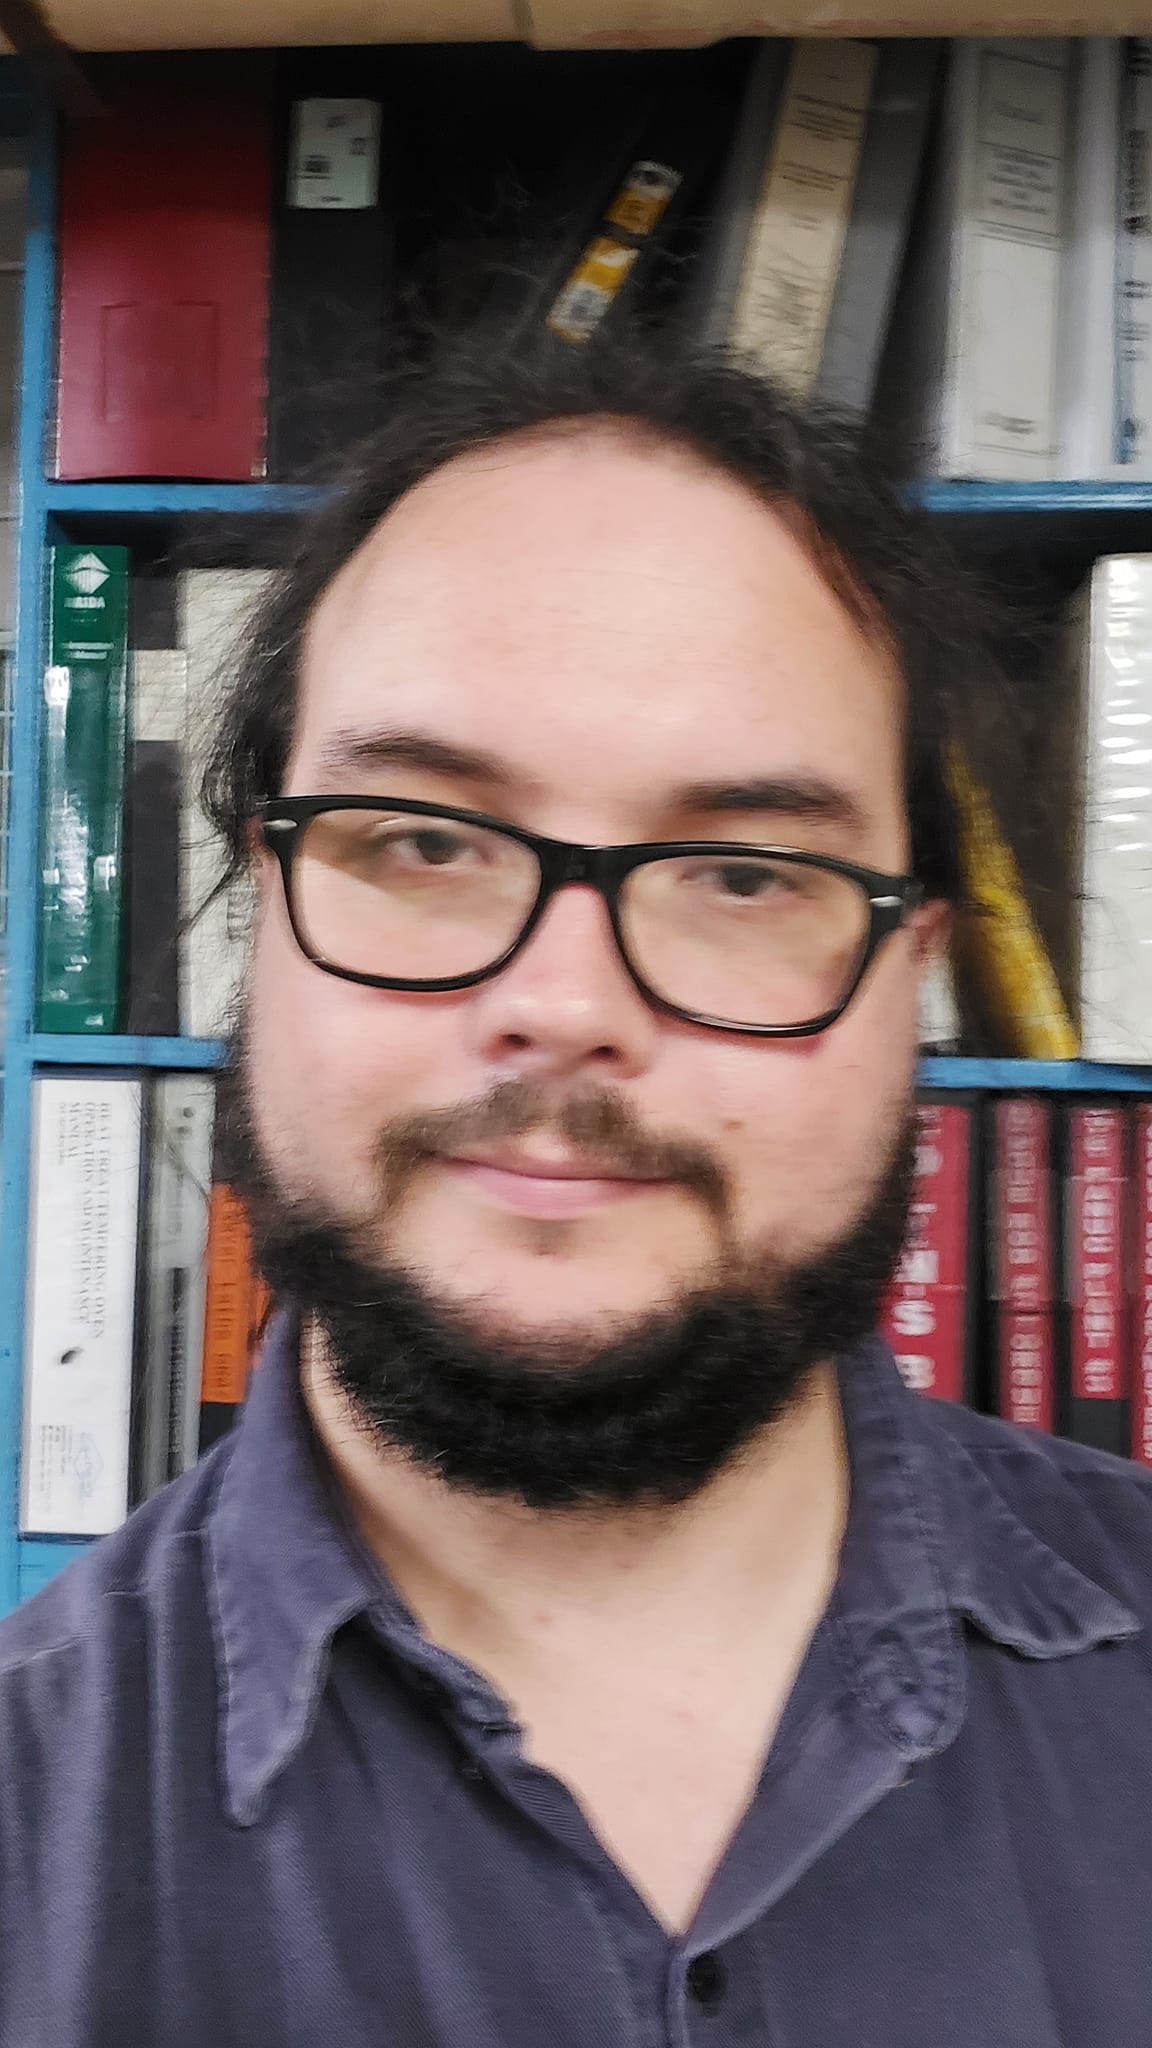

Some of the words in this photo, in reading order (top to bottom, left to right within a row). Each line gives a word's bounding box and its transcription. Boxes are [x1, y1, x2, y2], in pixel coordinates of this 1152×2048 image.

[67, 1101, 81, 1159] MANUAL
[82, 1101, 96, 1182] OPERATION
[98, 1102, 112, 1141] HEAT
[97, 1148, 111, 1196] TREAT
[81, 1188, 94, 1217] AND
[78, 1217, 93, 1326] MAINTENANCE
[95, 1202, 110, 1293] TEMPERING
[93, 1295, 107, 1340] OVEN
